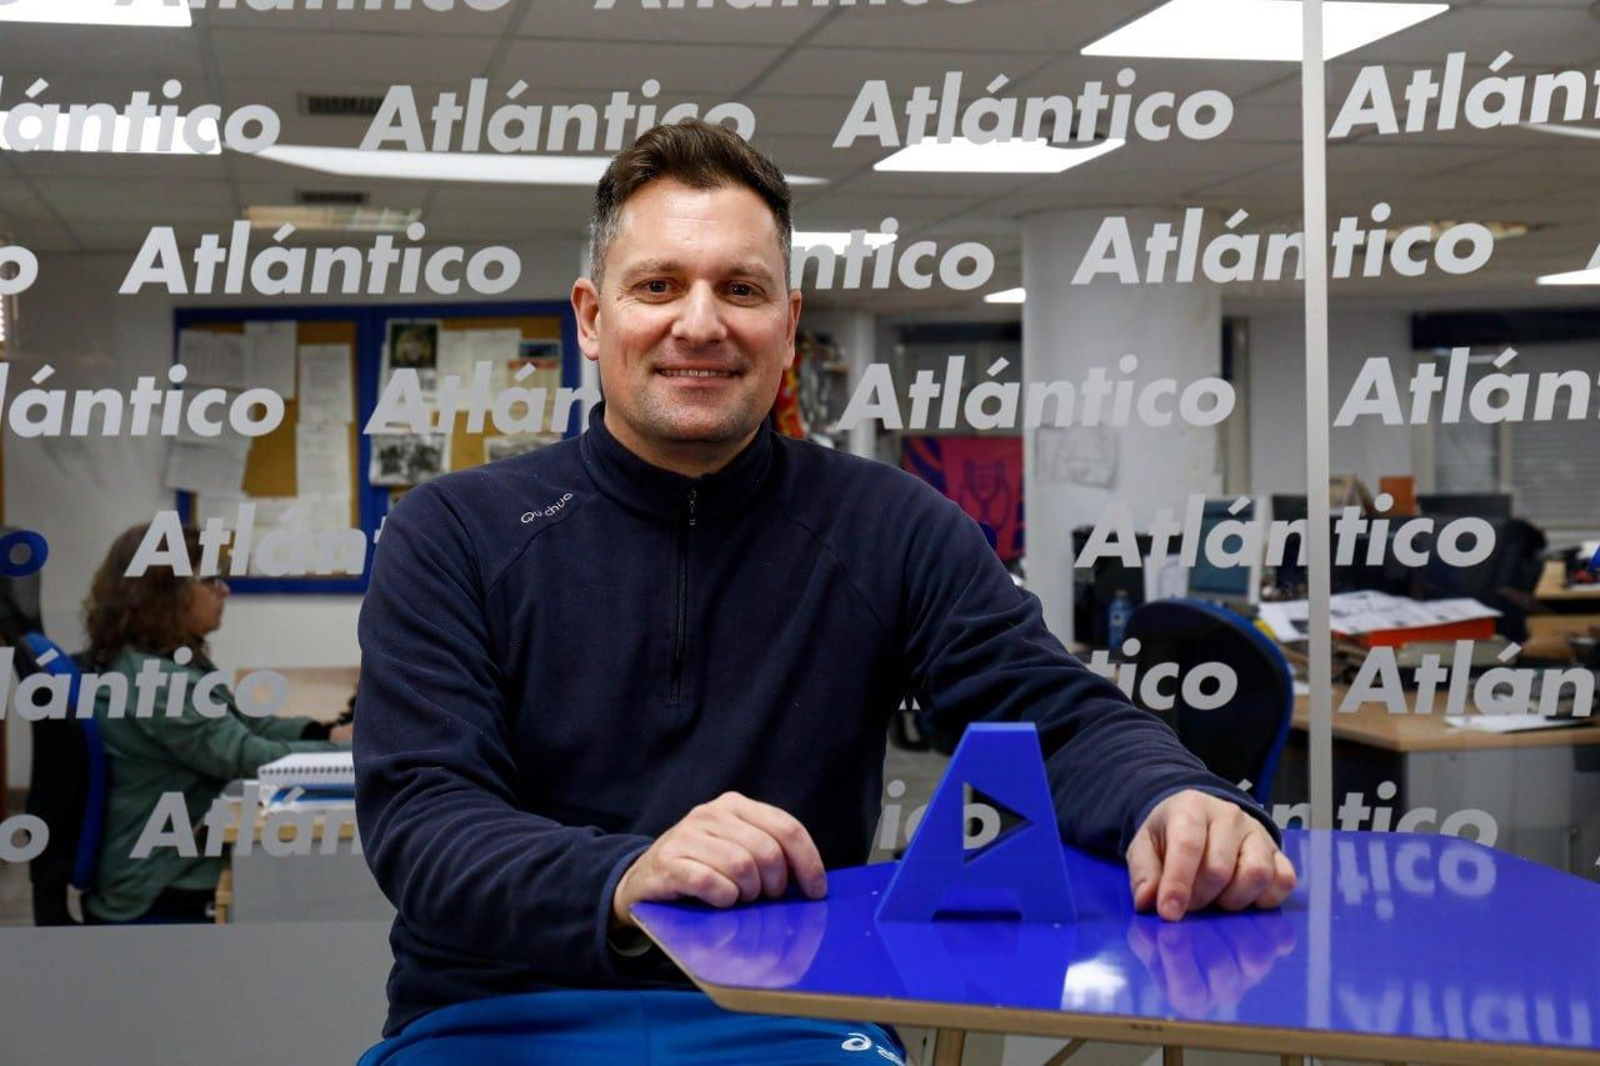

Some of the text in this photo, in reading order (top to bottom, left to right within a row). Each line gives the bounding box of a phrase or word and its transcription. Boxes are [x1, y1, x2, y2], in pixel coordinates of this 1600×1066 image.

[0, 76, 280, 154] ántico
[832, 68, 1234, 148] Atlántico
[1328, 51, 1600, 138] Atlán
[118, 220, 522, 295] Atlántico
[1070, 202, 1494, 285] Atlántico
[0, 362, 285, 438] ántico
[837, 355, 1236, 429] Atlántico
[1333, 346, 1600, 427] Atlán
[123, 503, 386, 577] Atlán
[520, 492, 573, 523] Quchua
[1074, 493, 1496, 569] Atlántico
